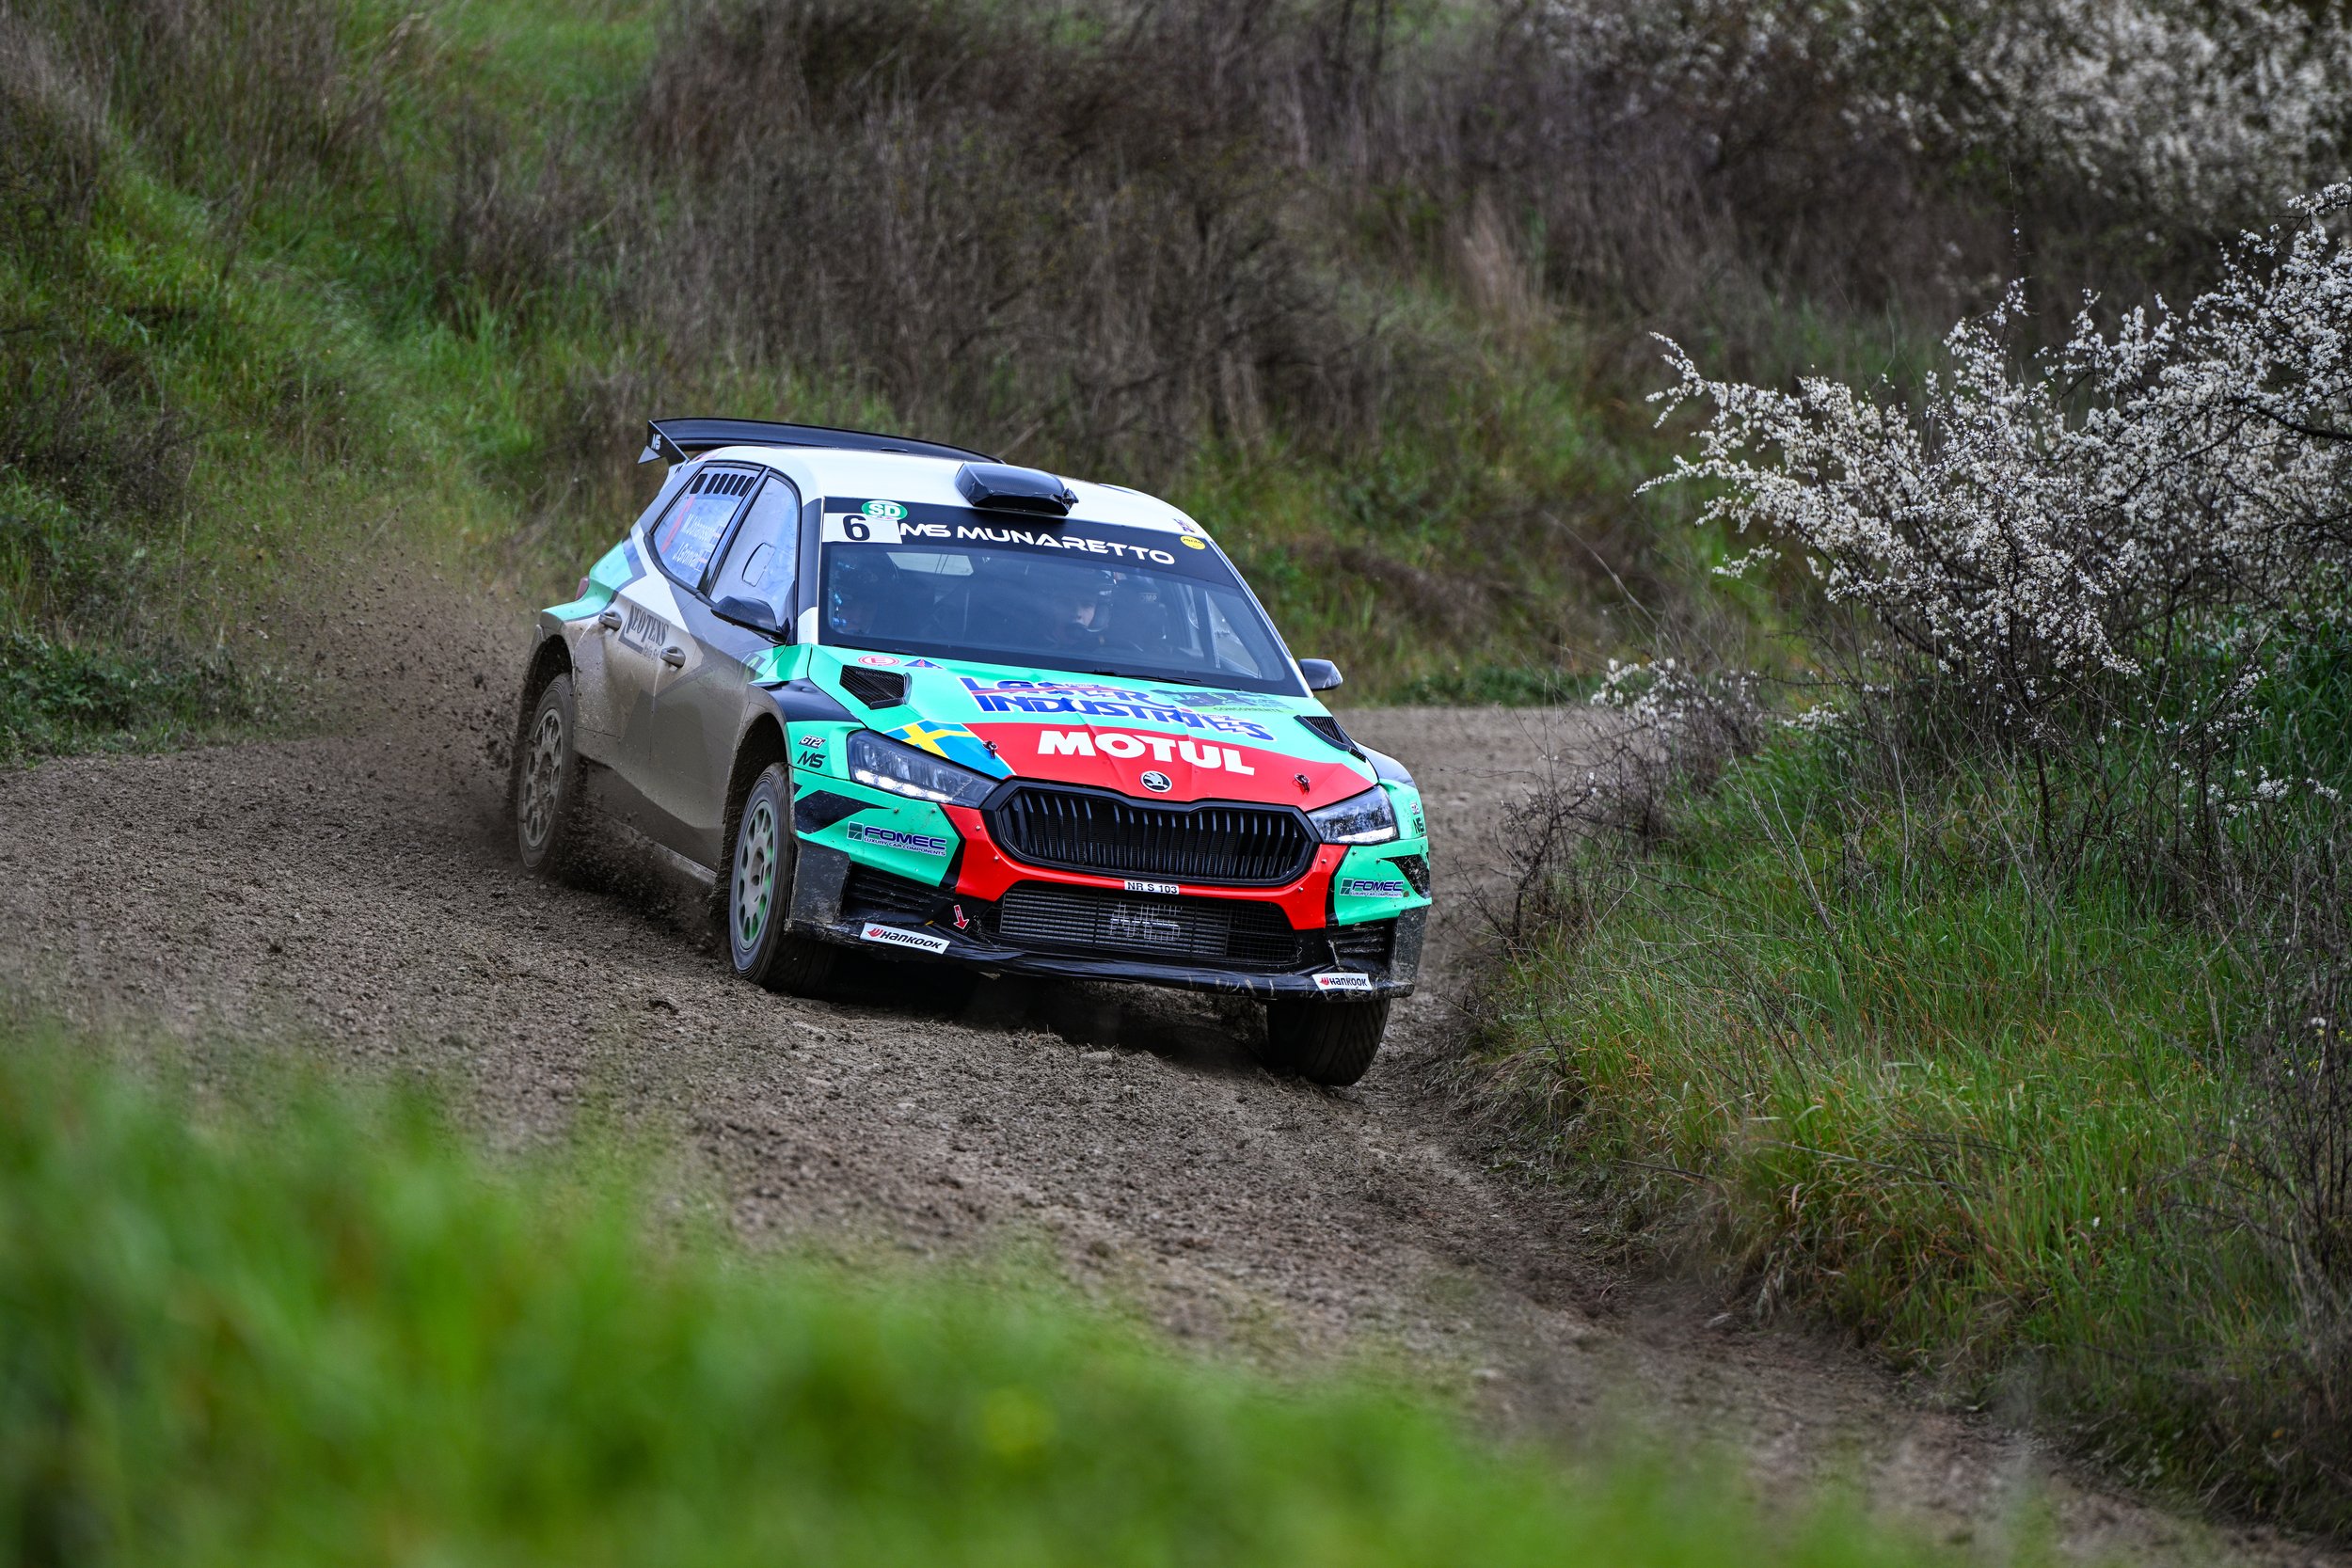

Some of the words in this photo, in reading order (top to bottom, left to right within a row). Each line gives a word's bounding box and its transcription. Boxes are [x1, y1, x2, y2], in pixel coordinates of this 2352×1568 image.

[868, 503, 900, 518] SD
[842, 515, 870, 542] 6
[899, 522, 951, 538] MS
[957, 525, 1175, 565] MUNARETTO
[797, 751, 826, 768] MS
[1038, 730, 1255, 776] MOTUL
[864, 826, 946, 850] FOMEC
[902, 845, 946, 857] COMPONENTS
[1127, 881, 1144, 891] NR
[1147, 883, 1155, 892] S
[1158, 884, 1178, 895] 103
[1352, 880, 1405, 893] FOMEC
